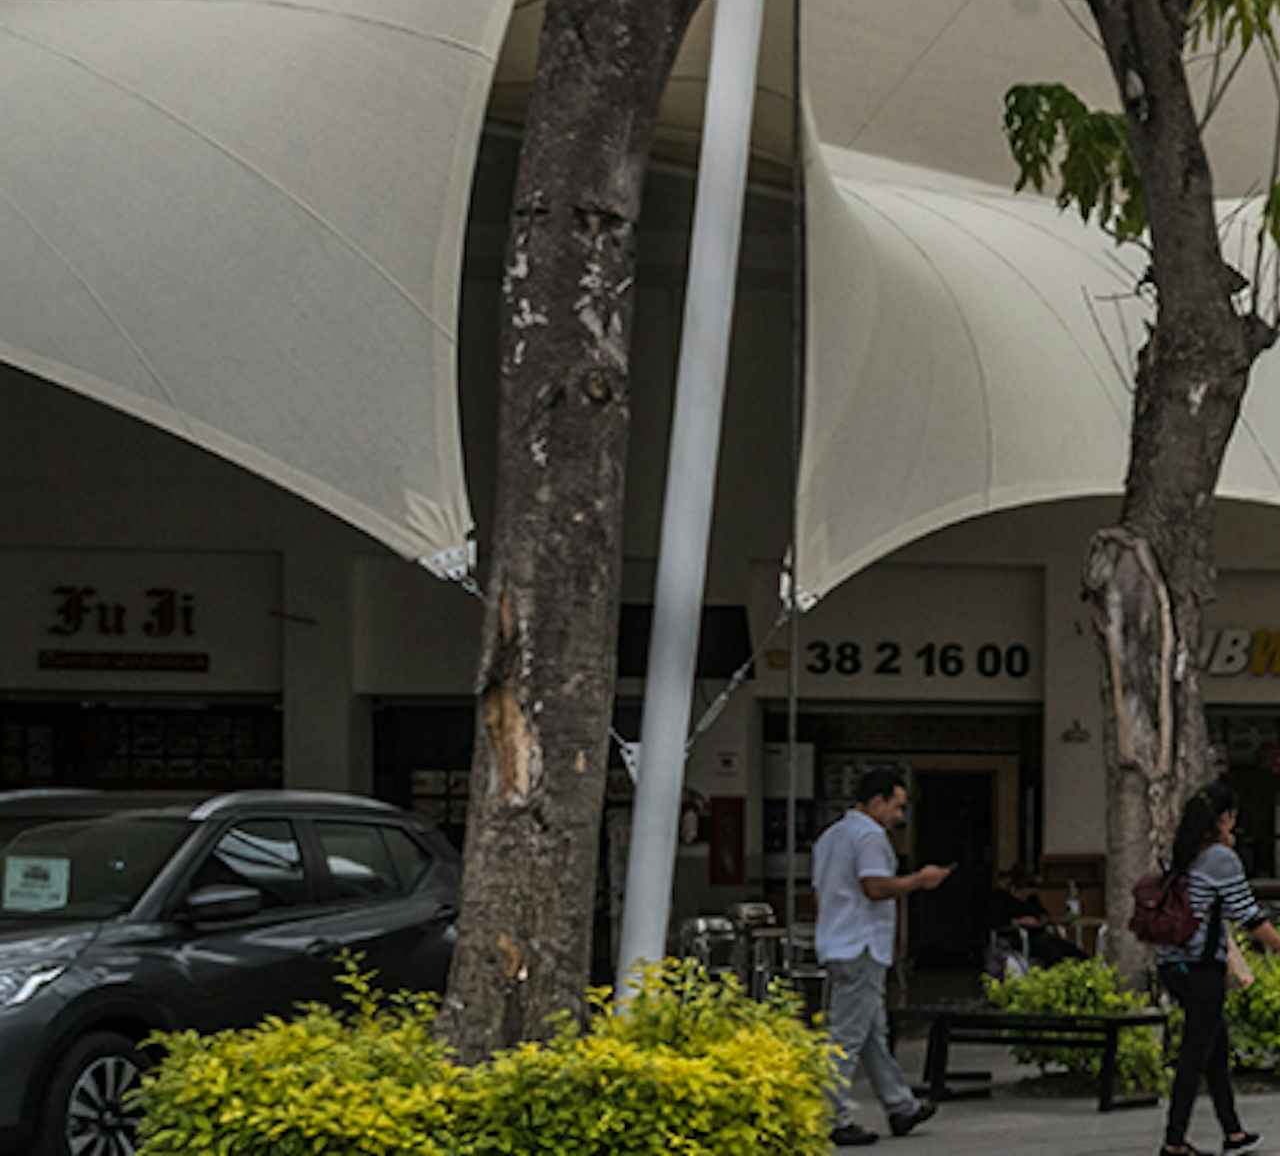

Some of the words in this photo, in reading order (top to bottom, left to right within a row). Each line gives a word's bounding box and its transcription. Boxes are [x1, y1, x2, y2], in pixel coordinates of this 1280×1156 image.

[48, 585, 127, 636] Fu
[805, 641, 862, 676] 38
[874, 641, 903, 676] 2
[914, 643, 966, 678] 16
[975, 643, 1031, 678] 00
